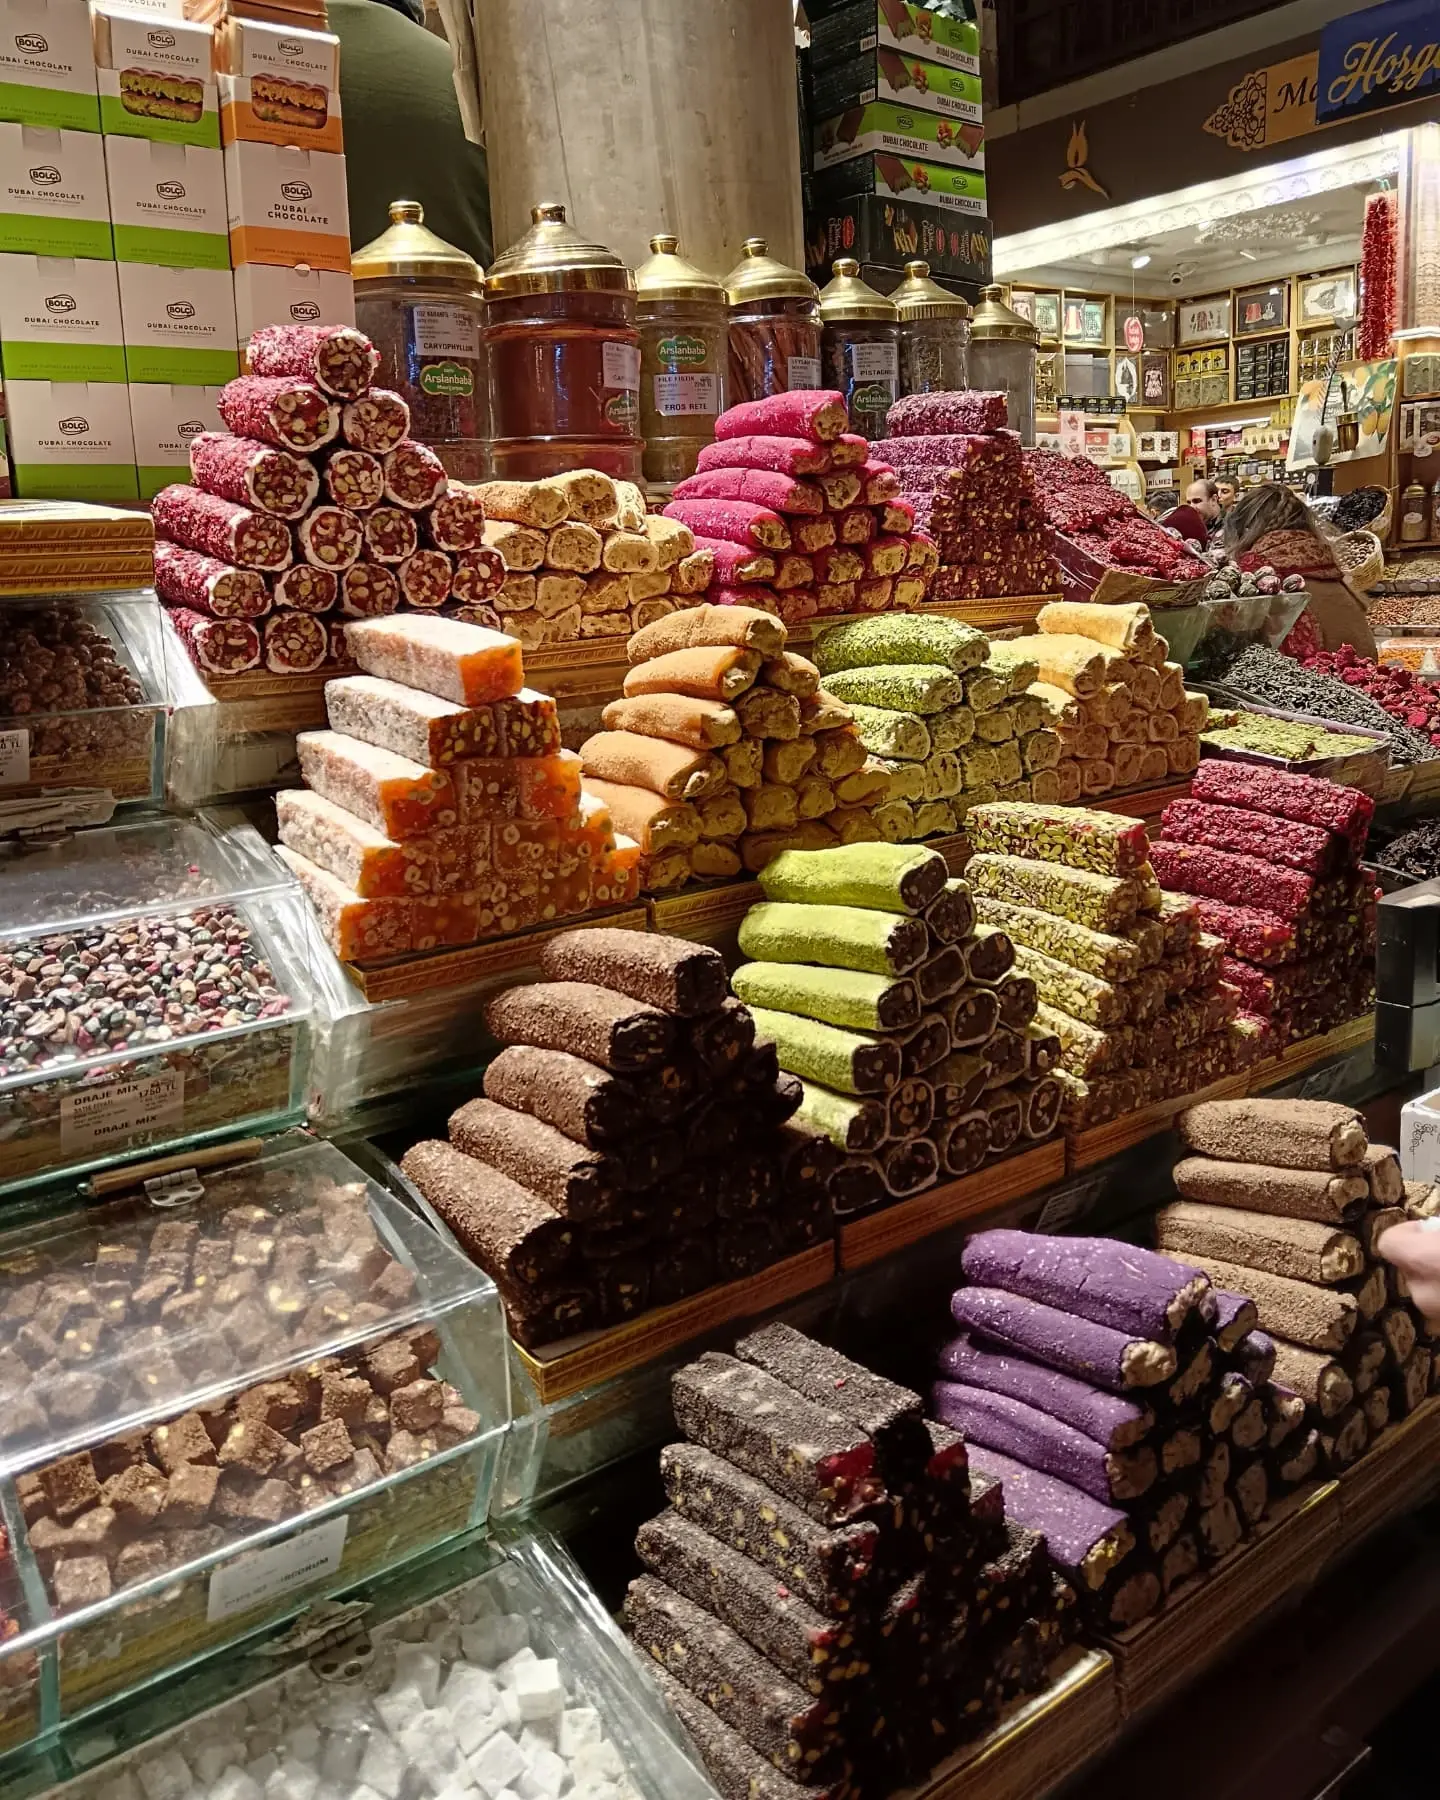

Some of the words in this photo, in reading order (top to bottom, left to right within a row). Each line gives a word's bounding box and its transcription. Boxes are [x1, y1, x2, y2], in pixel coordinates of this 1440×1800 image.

[126, 48, 151, 57] DUBAI
[153, 52, 200, 63] CHOCOLATE
[37, 190, 85, 201] CHOCOLATE
[136, 201, 161, 209] DUBAI
[163, 204, 207, 214] CHOCOLATE
[274, 203, 307, 214] DUBAI
[267, 211, 329, 225] CHOCOLATE
[53, 318, 100, 326] CHOCOLATE
[173, 324, 216, 332] CHOCOLATE
[660, 345, 706, 355] Arslanbaba
[424, 373, 472, 386] Arslanbaba
